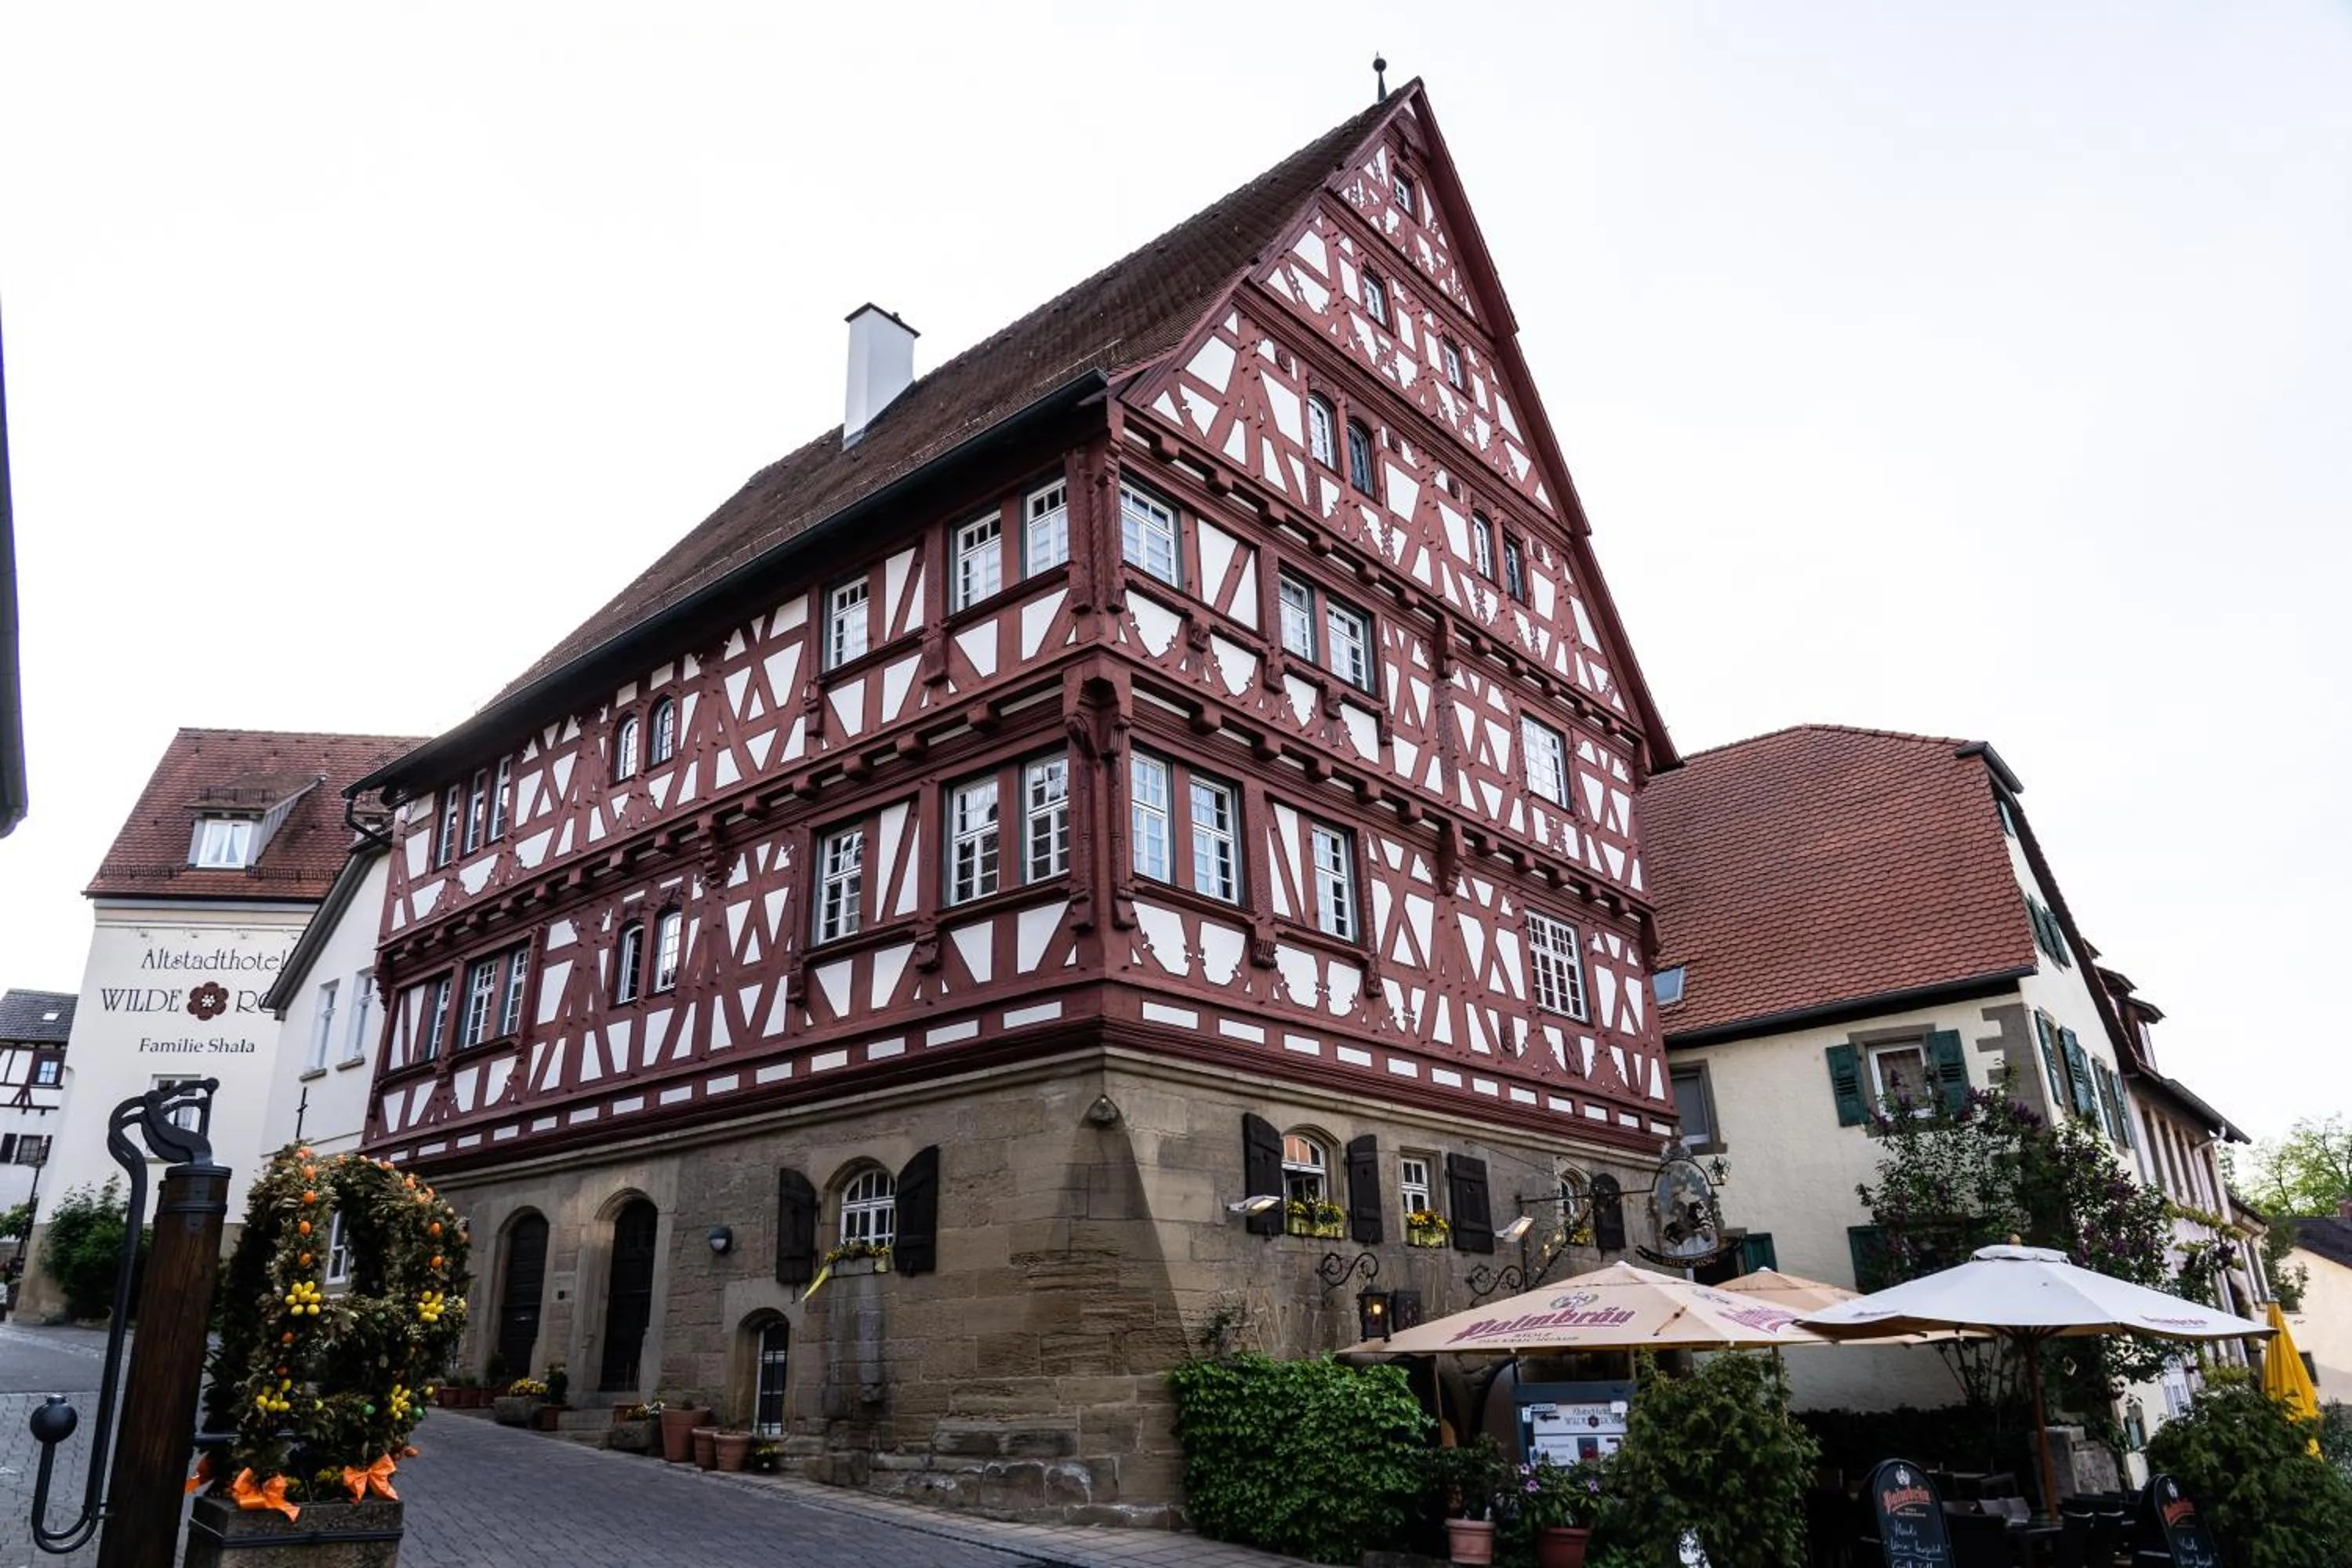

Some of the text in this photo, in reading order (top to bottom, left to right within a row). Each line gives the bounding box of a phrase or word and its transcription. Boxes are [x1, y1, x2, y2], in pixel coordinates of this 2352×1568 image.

[140, 948, 285, 971] Altstadthotel
[100, 988, 183, 1012] WILDE
[138, 1036, 256, 1053] Familie Shala
[1446, 1307, 1636, 1344] Palmbräu
